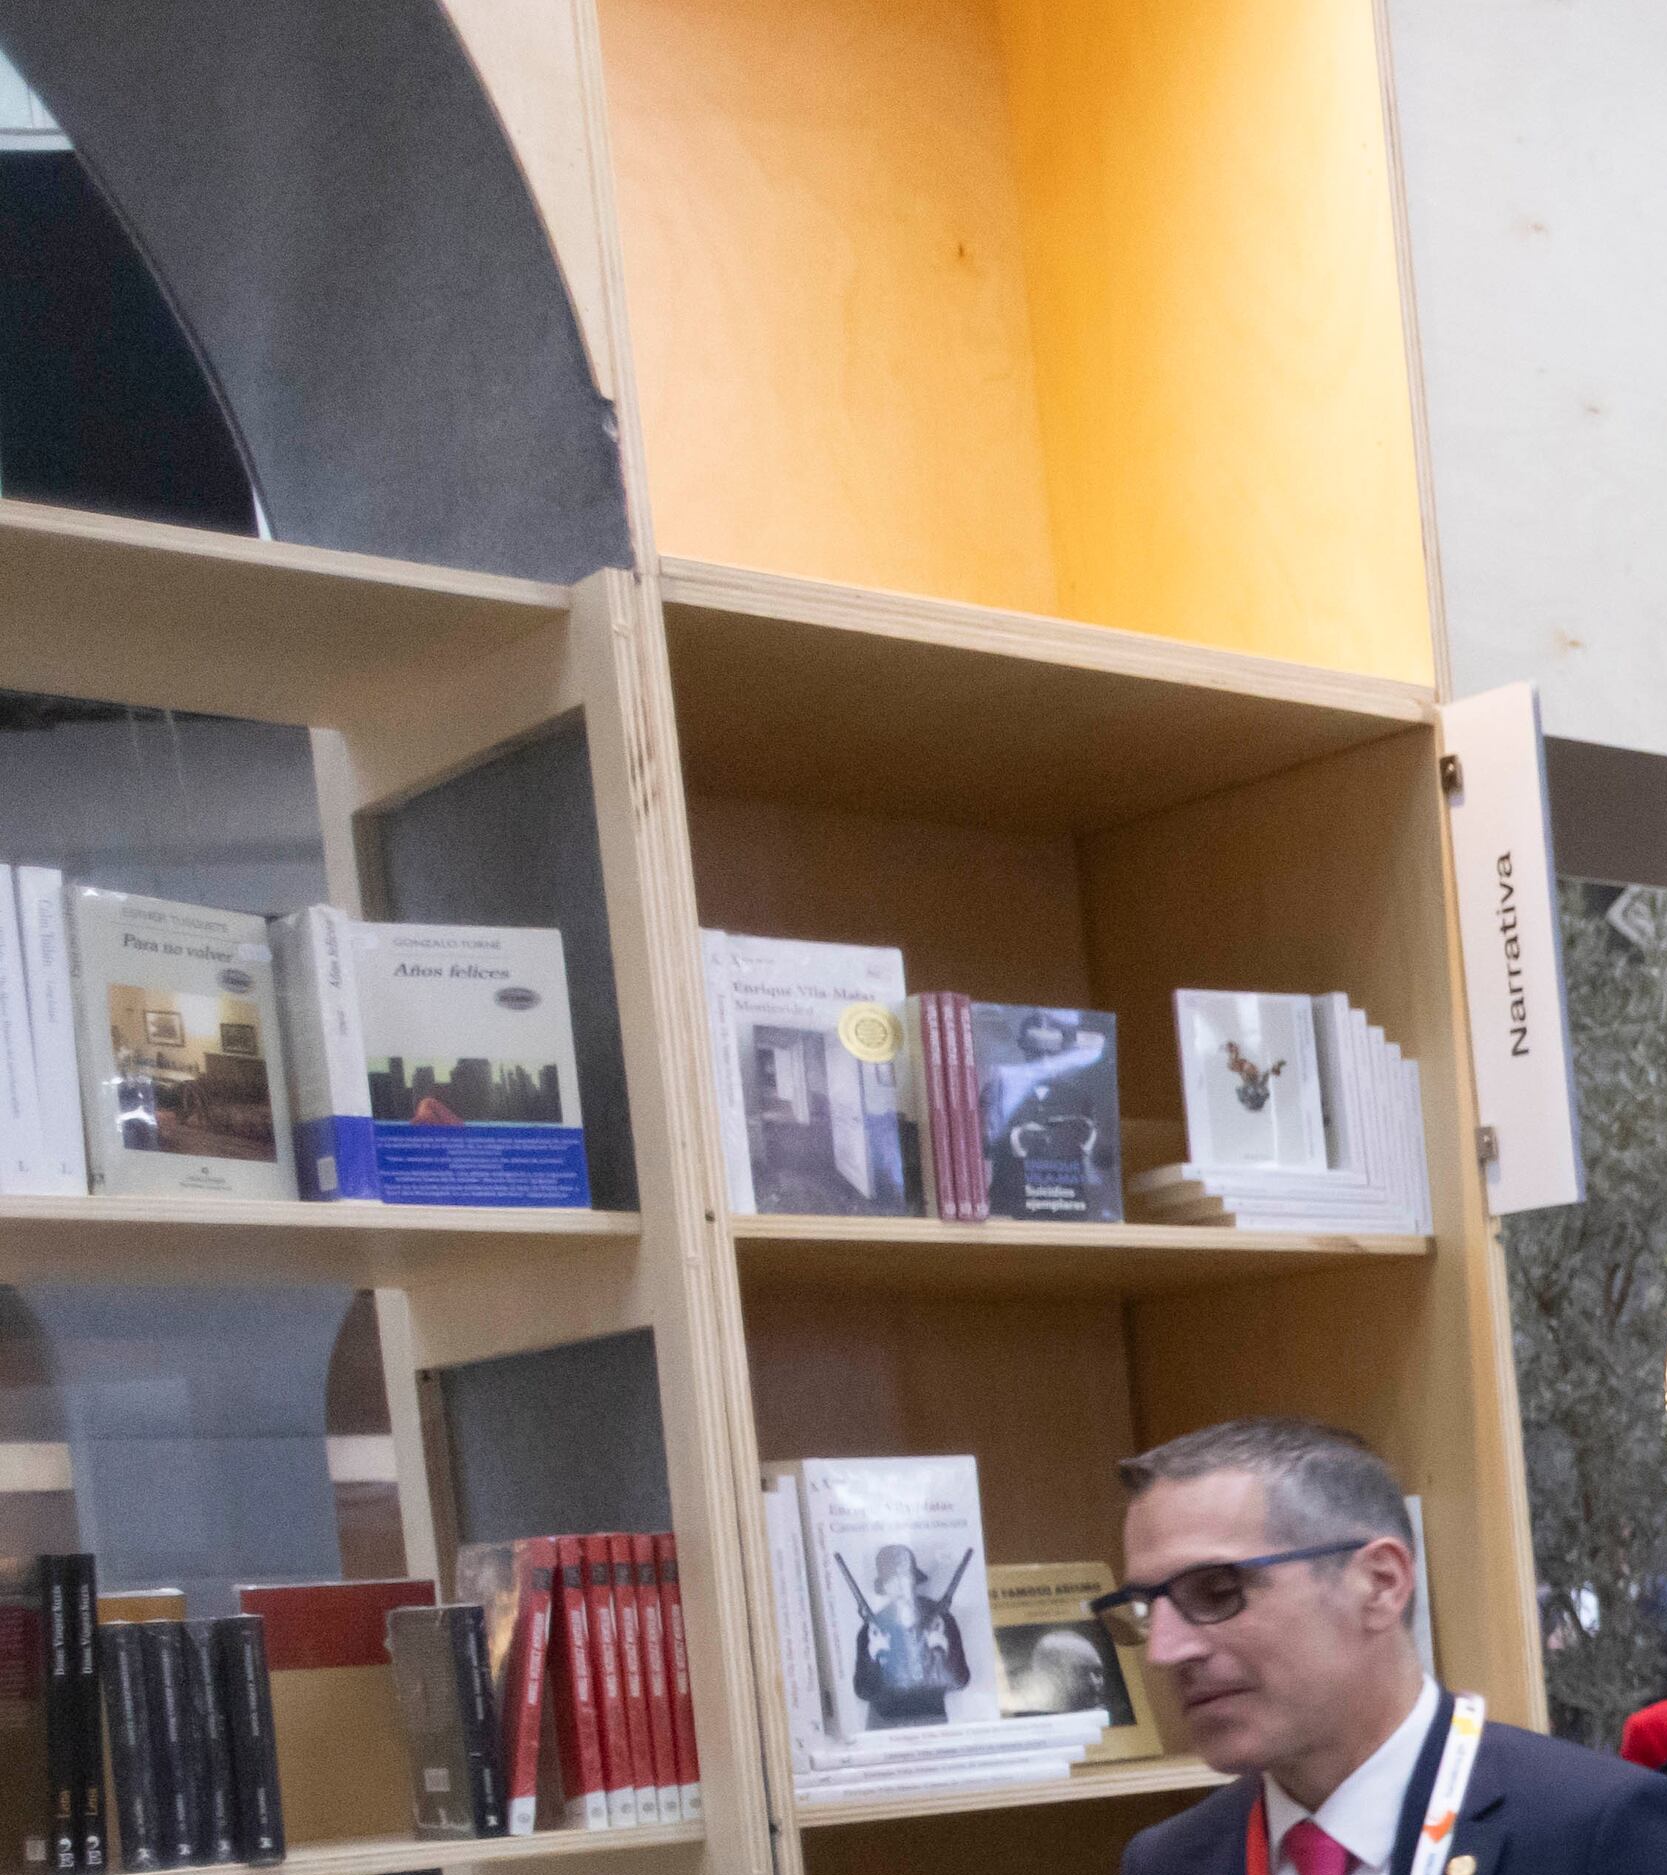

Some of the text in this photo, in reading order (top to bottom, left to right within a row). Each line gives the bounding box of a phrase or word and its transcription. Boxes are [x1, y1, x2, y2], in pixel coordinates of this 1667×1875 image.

[123, 933, 235, 963] Para no volver
[1496, 850, 1529, 1057] Narrativa
[393, 962, 511, 980] Años felices
[733, 982, 792, 998] Enrique
